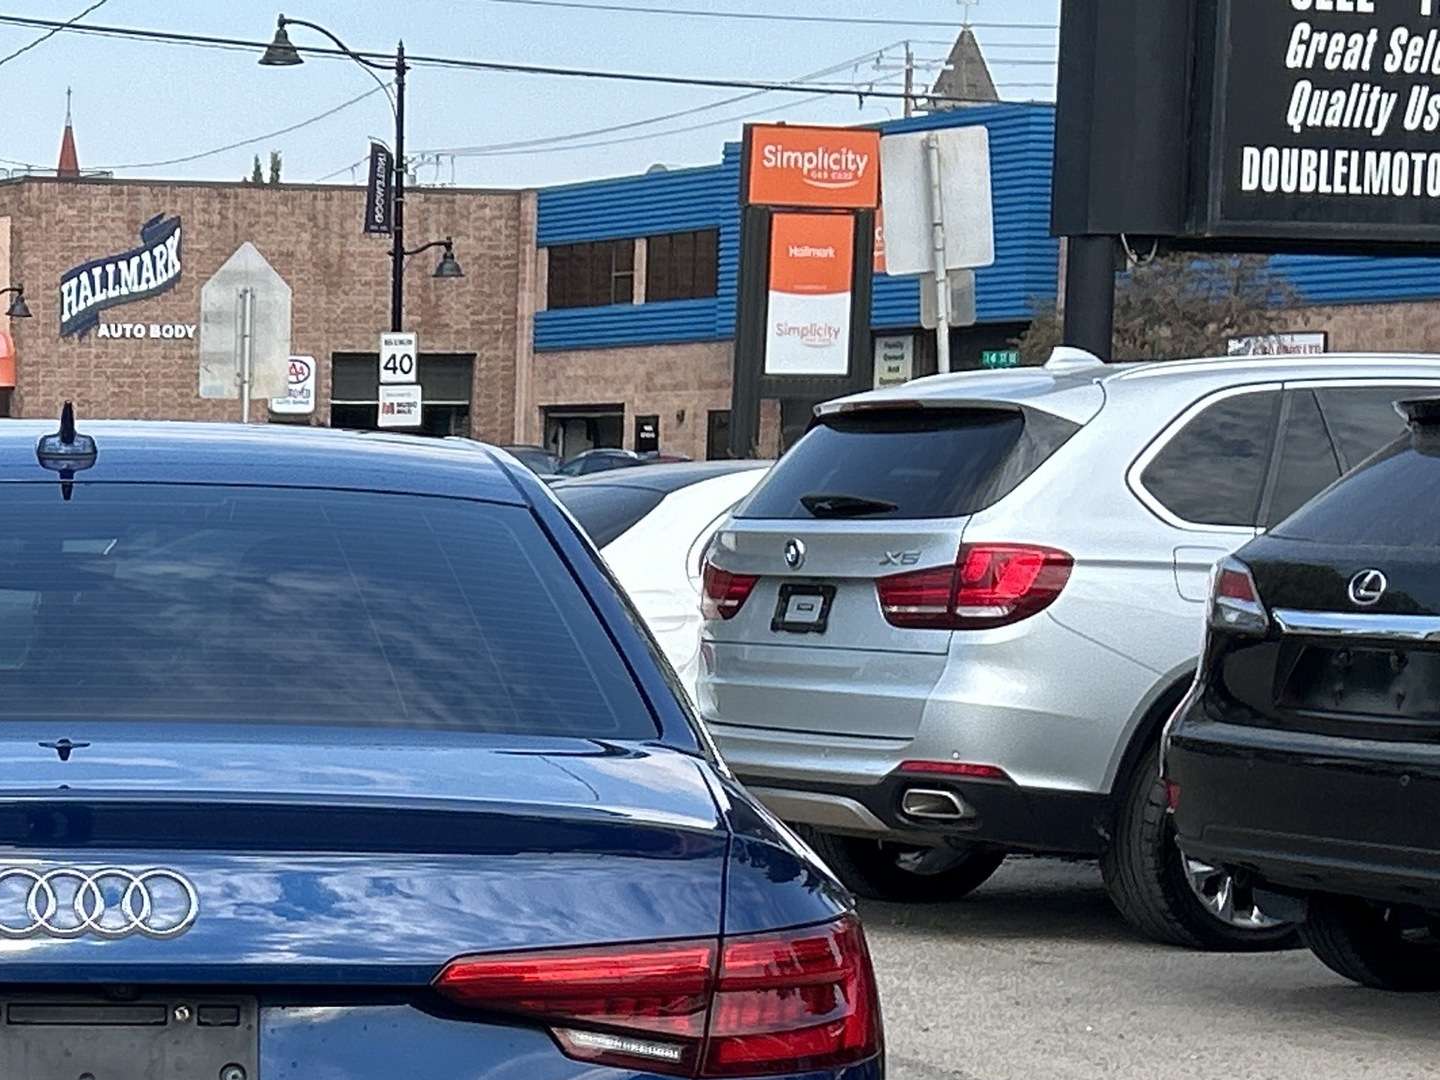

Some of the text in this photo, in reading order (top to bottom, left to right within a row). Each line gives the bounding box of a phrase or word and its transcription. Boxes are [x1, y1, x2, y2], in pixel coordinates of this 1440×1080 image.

[1286, 21, 1379, 71] Great
[1286, 79, 1398, 136] Quality
[763, 144, 869, 178] Simplicity
[1241, 146, 1440, 197] DOUBLELMOTO
[788, 245, 836, 258] Hallmark
[60, 227, 181, 323] HALLMARK
[98, 323, 197, 338] AUTO BODY
[775, 323, 841, 340] Simplicity
[383, 353, 413, 375] 40
